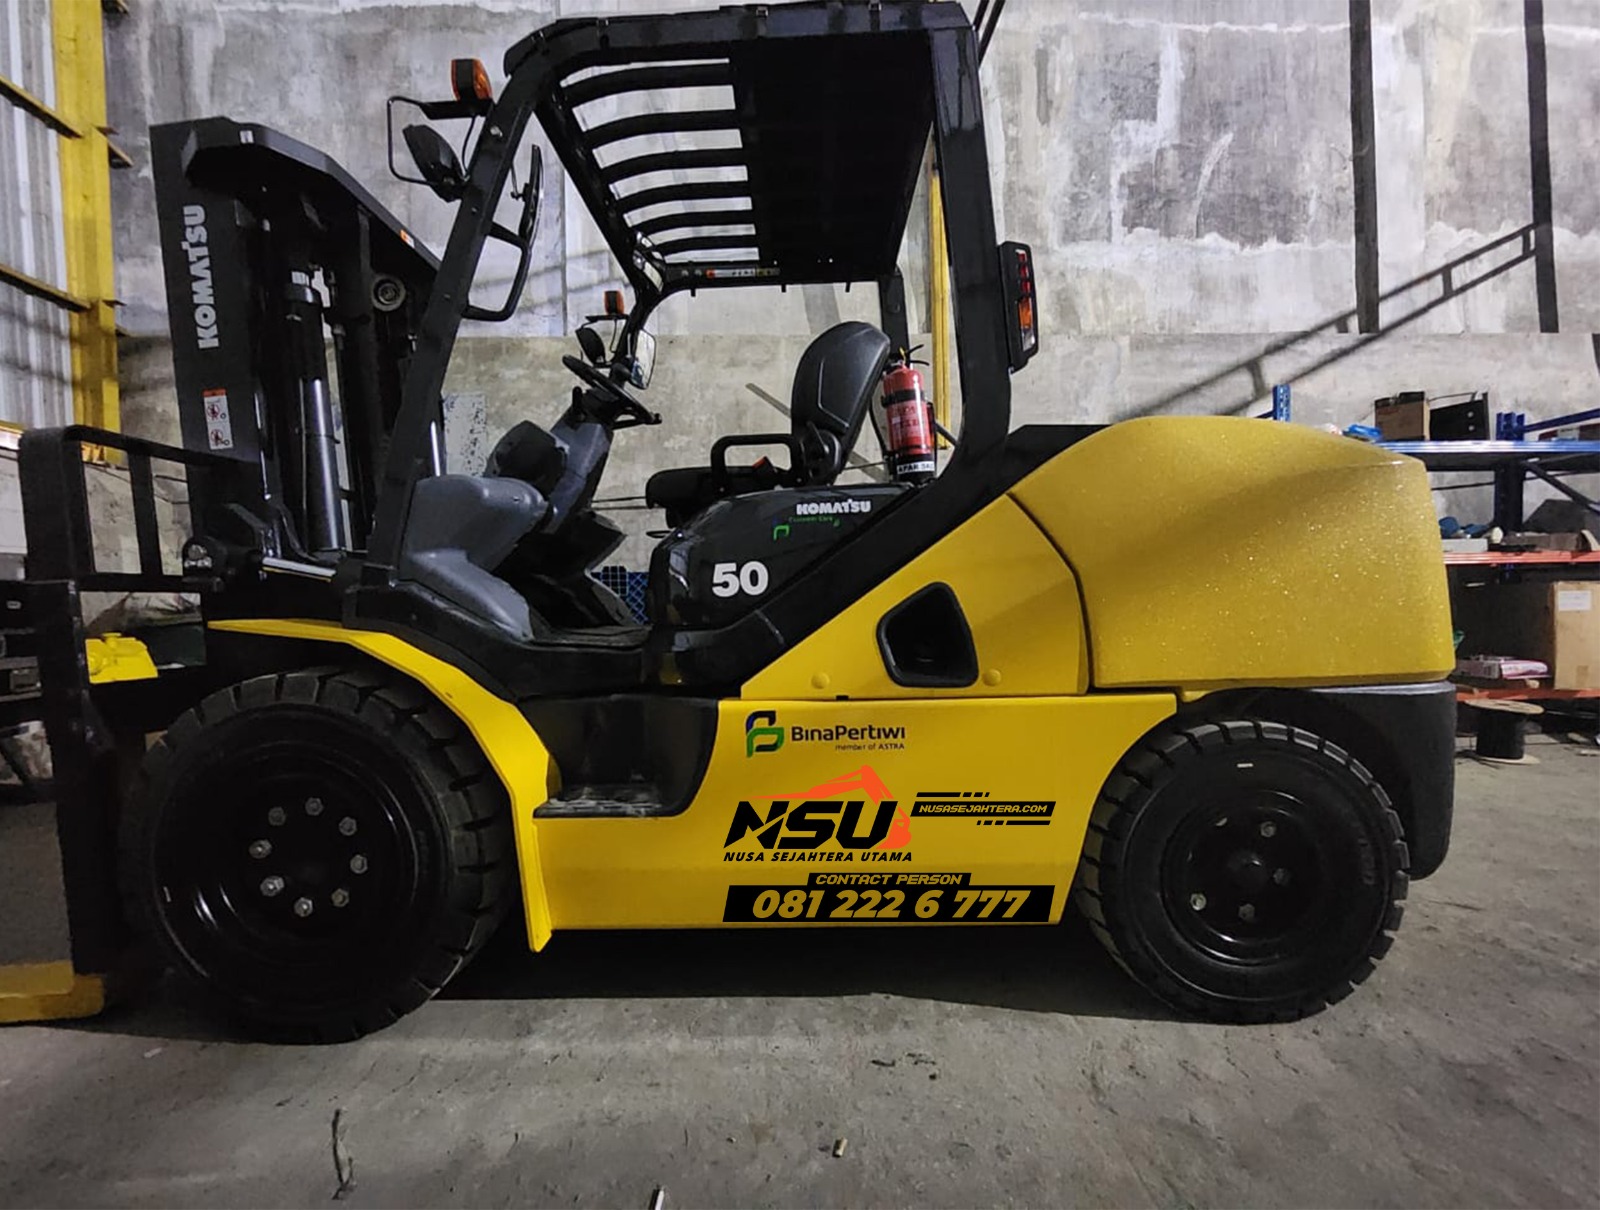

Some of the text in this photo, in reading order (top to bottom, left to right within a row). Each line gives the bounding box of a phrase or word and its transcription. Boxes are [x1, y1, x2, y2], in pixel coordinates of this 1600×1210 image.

[182, 204, 219, 349] KOMATSU
[796, 498, 871, 515] KOMATSU
[711, 560, 769, 598] 50
[791, 724, 906, 742] BinaPertiwi
[835, 743, 866, 751] member
[918, 804, 1048, 813] NUSASEJAHTERA.COM
[723, 800, 899, 849] NSU
[723, 852, 913, 862] NUSA SEJAHTERA UTAMA
[815, 874, 963, 885] CONTACT PERSON
[752, 889, 1031, 919] 081 222 6 777
